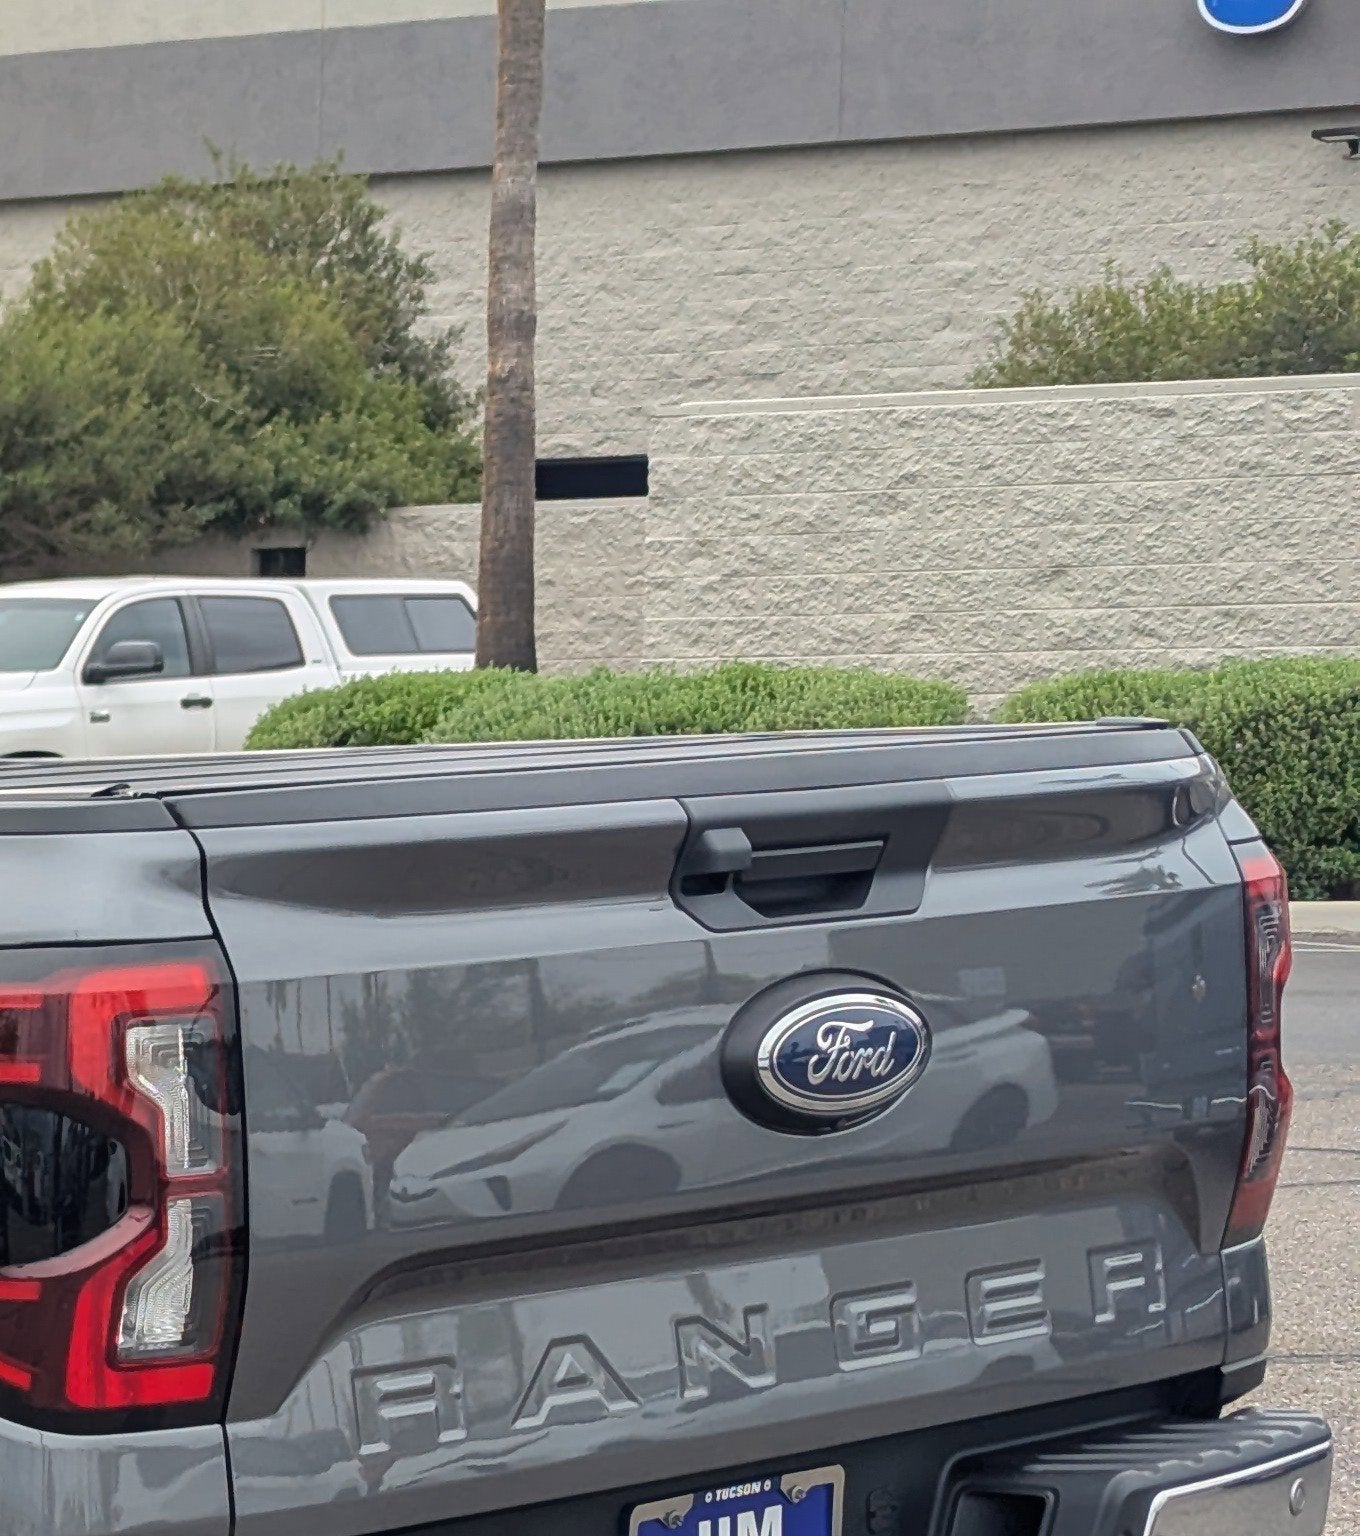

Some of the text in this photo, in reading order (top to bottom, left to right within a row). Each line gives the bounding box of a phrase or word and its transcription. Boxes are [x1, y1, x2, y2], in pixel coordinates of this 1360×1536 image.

[807, 1020, 896, 1085] Ford
[351, 1240, 1168, 1455] RANGER
[715, 1480, 761, 1502] TUCSON
